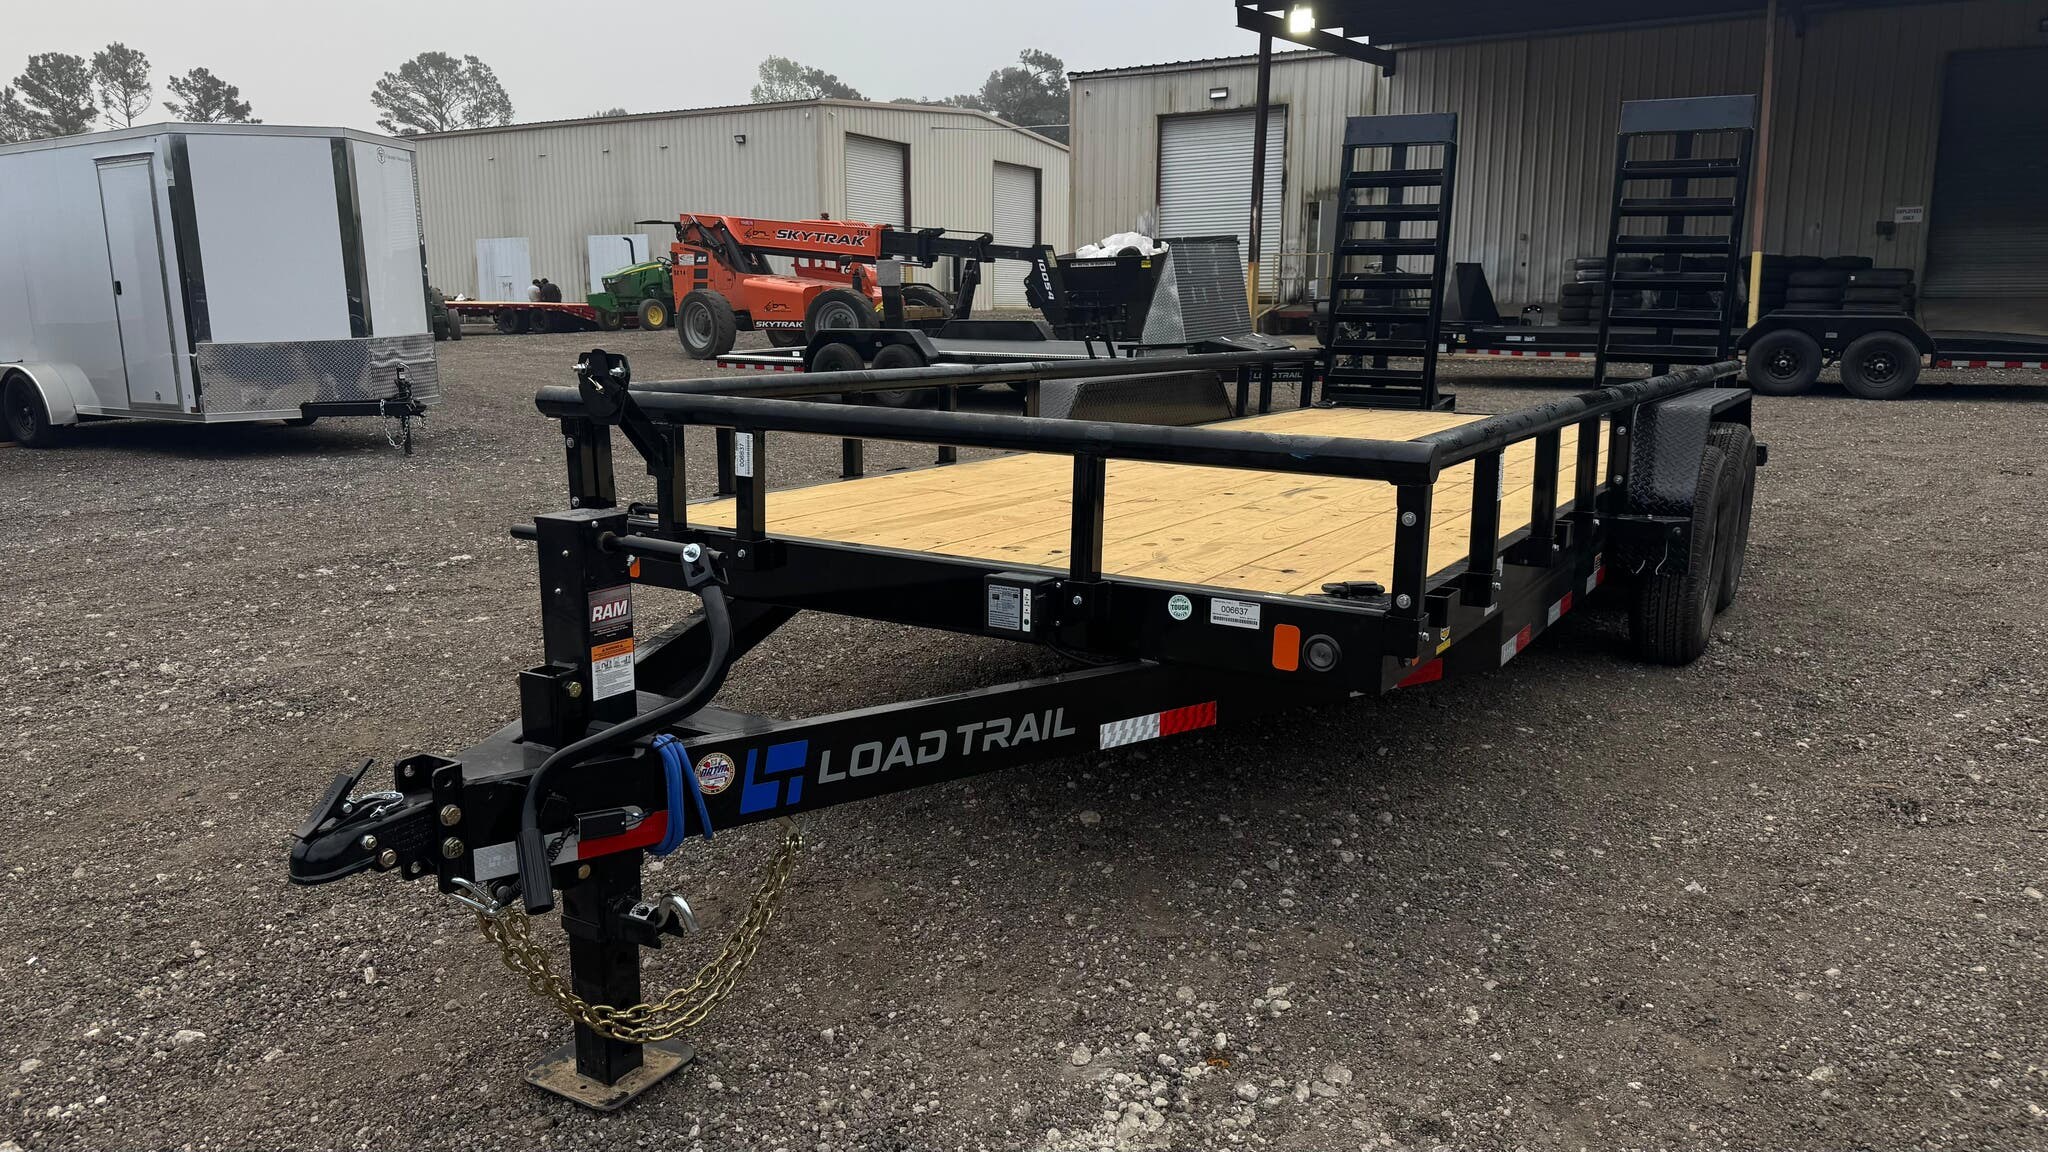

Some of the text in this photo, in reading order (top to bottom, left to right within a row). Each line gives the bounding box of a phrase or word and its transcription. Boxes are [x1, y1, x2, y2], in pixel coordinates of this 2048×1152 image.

[775, 229, 866, 247] SKYTRAK
[1038, 259, 1055, 300] 10054
[755, 320, 803, 329] SKYTRAK
[592, 600, 628, 622] RAM
[1221, 605, 1248, 616] 006637
[818, 707, 1076, 784] LOAD TRAIL
